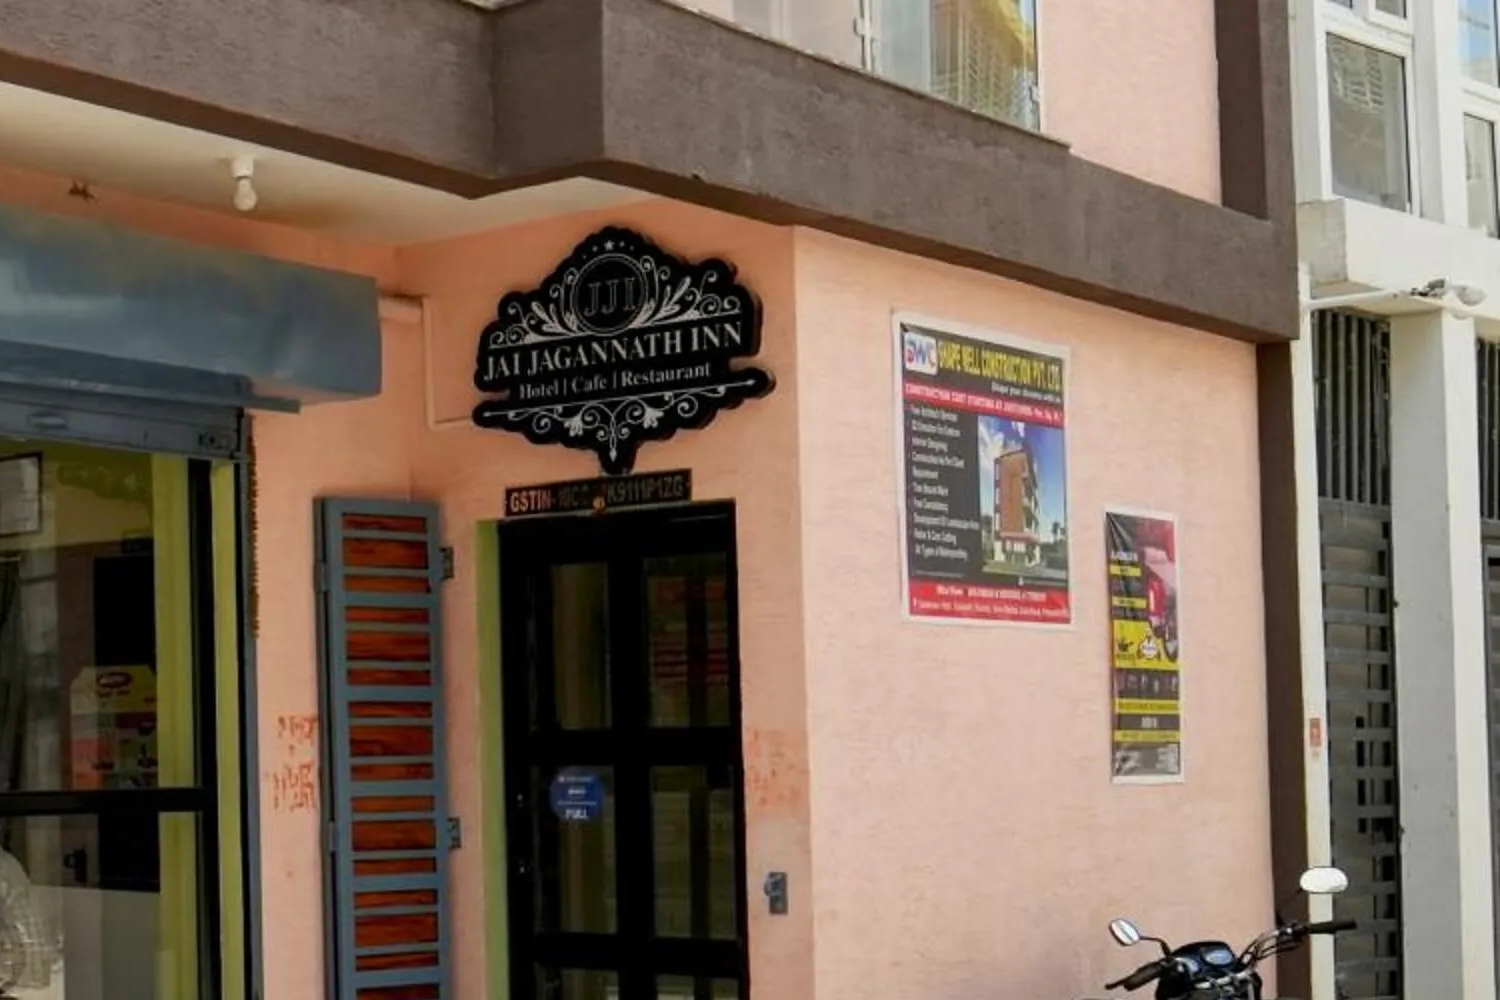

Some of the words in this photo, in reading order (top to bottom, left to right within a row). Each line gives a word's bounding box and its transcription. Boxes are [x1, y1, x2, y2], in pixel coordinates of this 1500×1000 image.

[483, 352, 521, 381] JAI
[526, 330, 682, 376] JAGANNATH
[690, 321, 743, 352] INN
[518, 379, 559, 400] Hotel
[571, 374, 608, 394] Cafe
[620, 361, 711, 388] Restaurant
